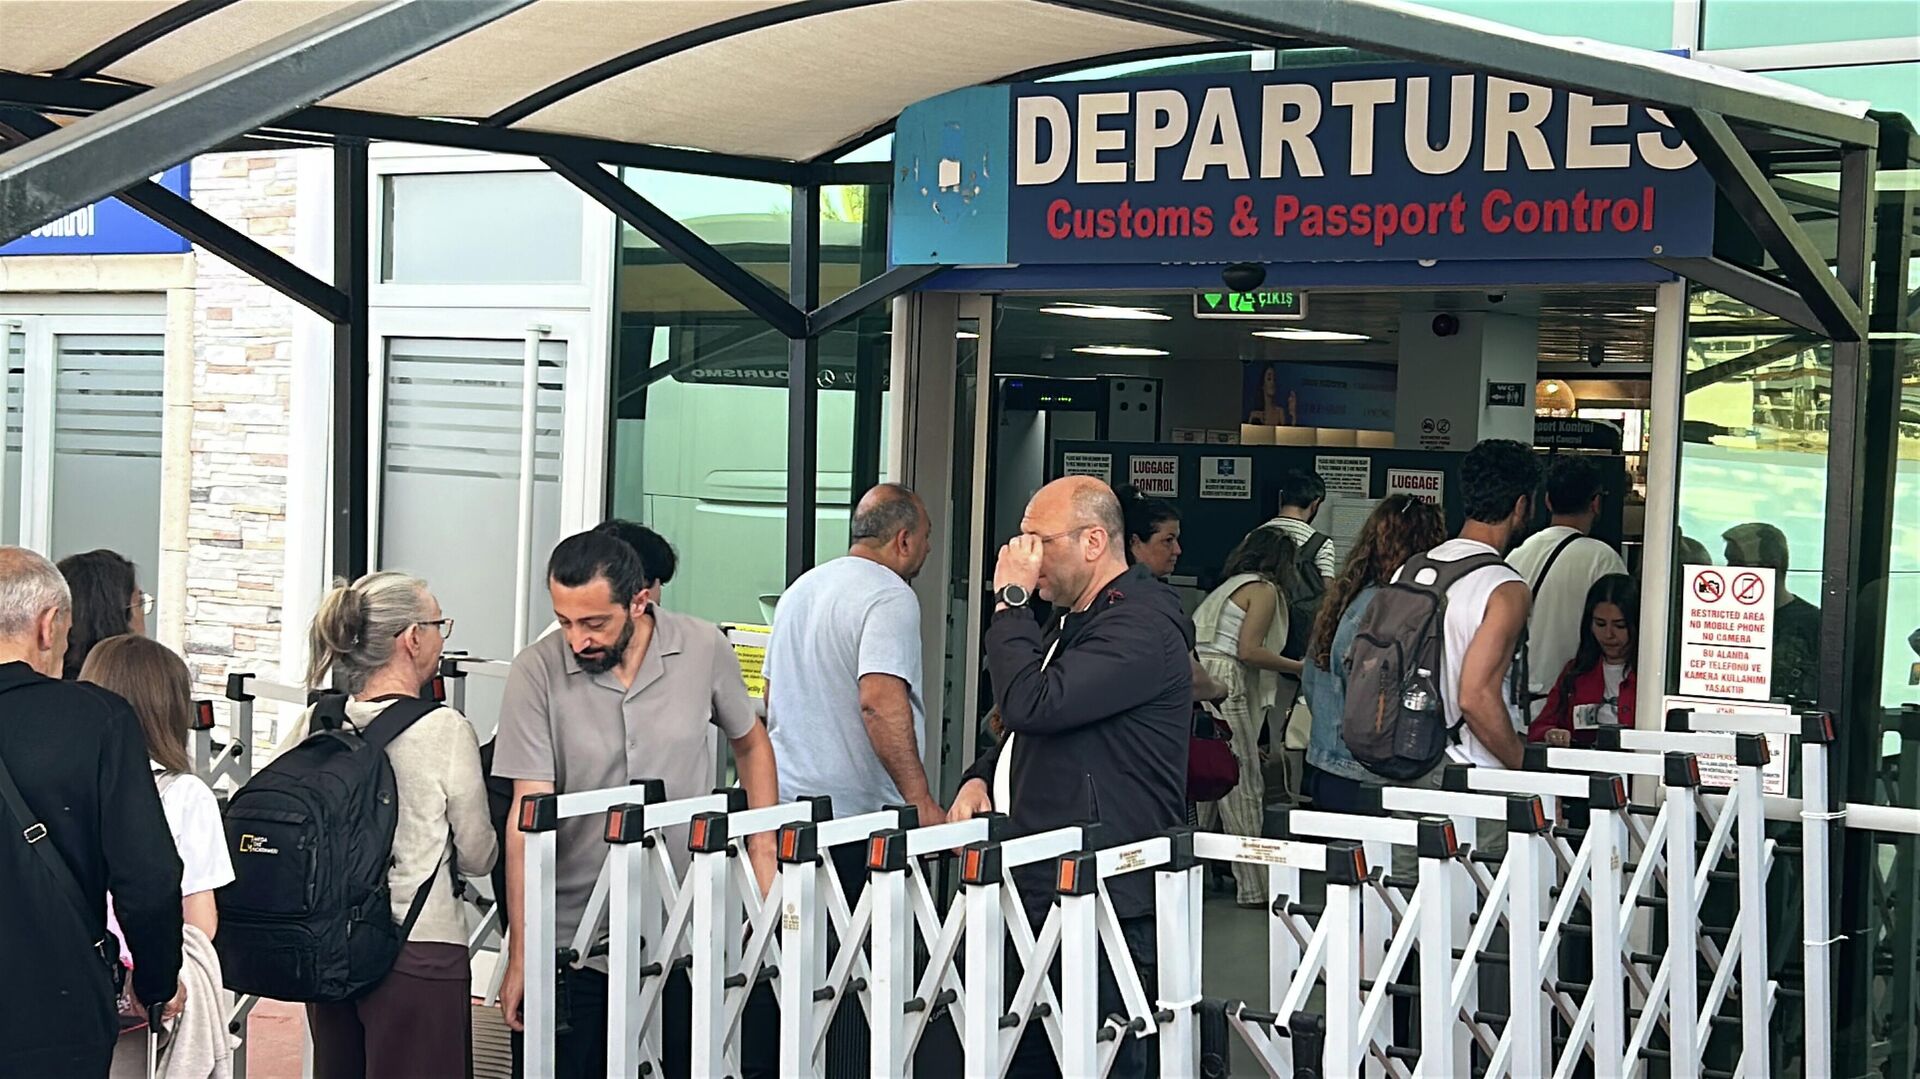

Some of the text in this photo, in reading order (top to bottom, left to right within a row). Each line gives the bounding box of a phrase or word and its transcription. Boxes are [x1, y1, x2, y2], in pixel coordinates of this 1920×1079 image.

[1016, 74, 1698, 185] DEPARTURES
[1046, 187, 1655, 247] Customs & Passport Control
[1258, 292, 1294, 308] ÇIKIŞ
[1133, 460, 1175, 474] LUGGAGE
[1133, 478, 1175, 492] CONTROL
[1391, 474, 1440, 491] LUGGAGE
[1691, 608, 1765, 621] RESTRICTED AREA
[1689, 620, 1765, 632] NO MOBILE PHONE
[1702, 632, 1751, 643] NO CAMERA
[1703, 648, 1749, 660] BU ALANDA
[1690, 659, 1762, 673] CEP TELEFONU VE
[1684, 670, 1766, 684] KAMERA KULLANIMI
[1705, 683, 1744, 694] YASAKTIR
